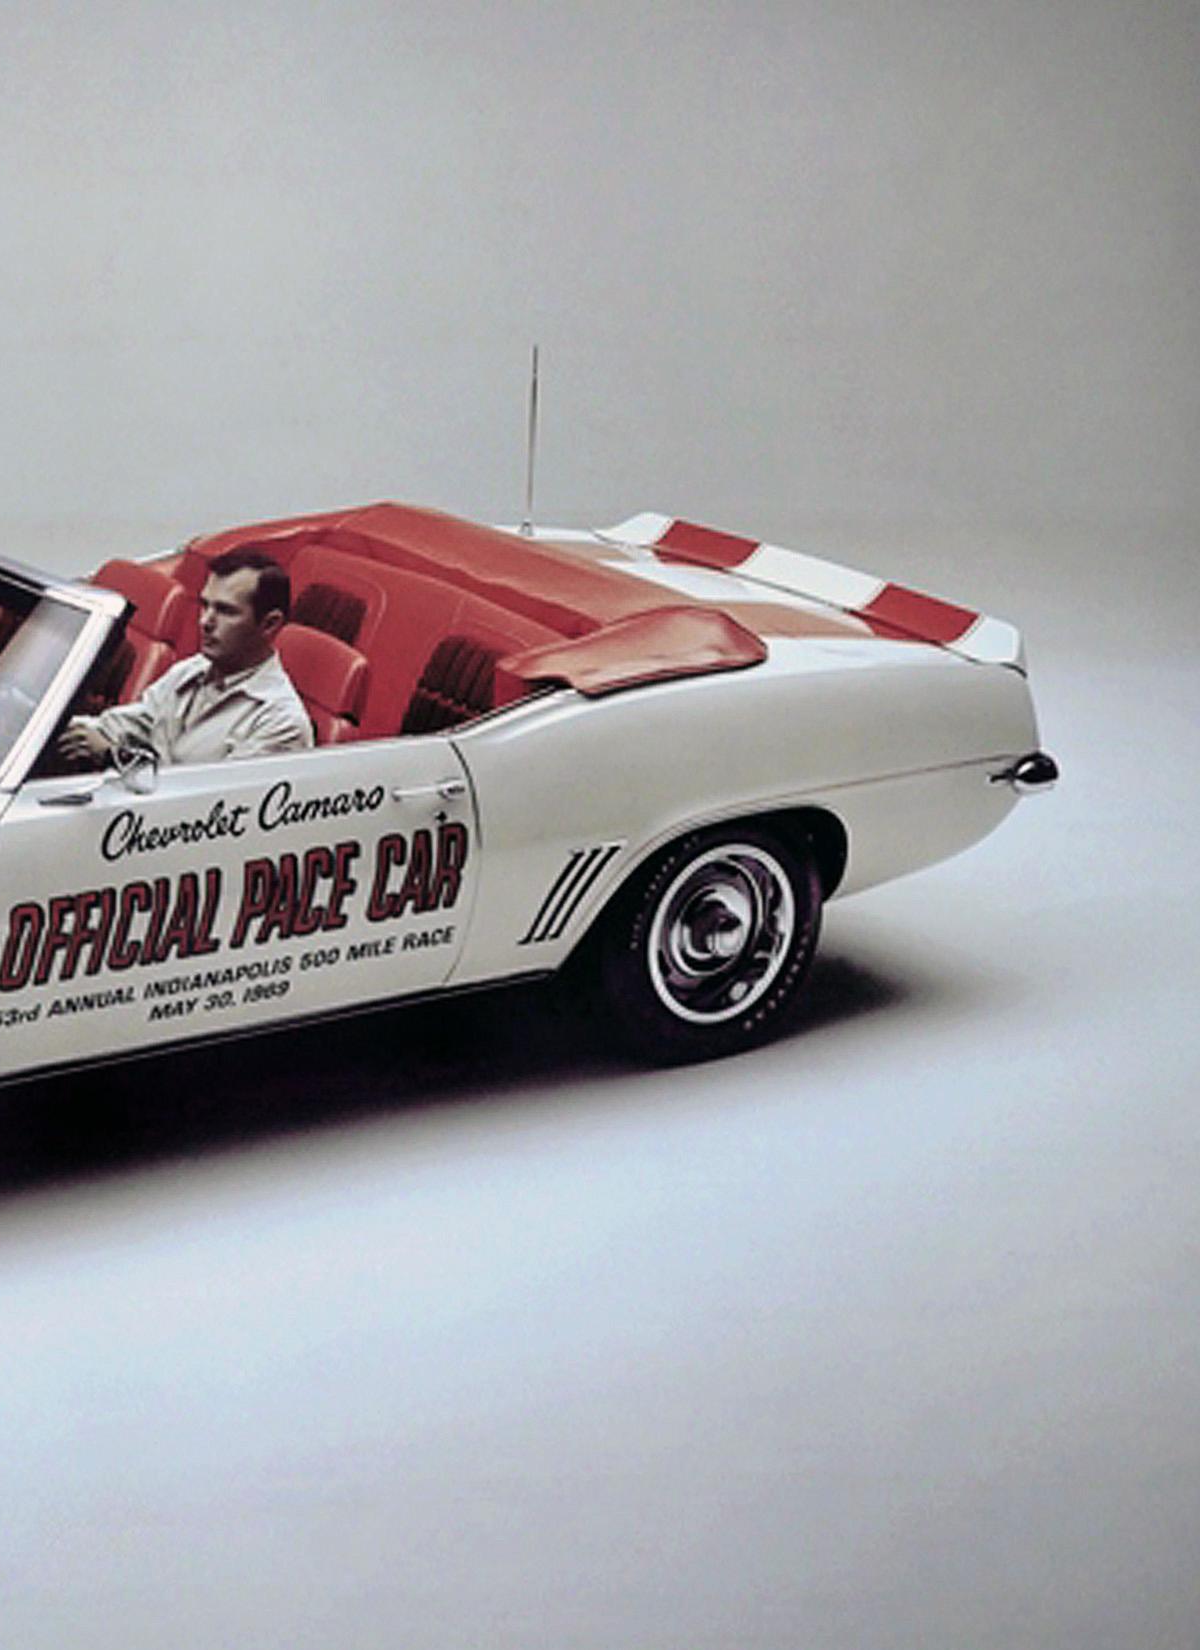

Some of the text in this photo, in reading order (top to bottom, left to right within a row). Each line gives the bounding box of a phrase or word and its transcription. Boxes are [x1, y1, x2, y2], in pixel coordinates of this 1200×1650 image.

[101, 781, 385, 861] Chevrolet Camaro
[229, 841, 360, 949] PACE
[366, 822, 468, 922] CAR
[47, 986, 136, 1018] ANNUAL
[143, 956, 293, 1000] INDIANAPOLIS
[300, 948, 340, 970] 500
[346, 936, 397, 961] MILE
[401, 926, 456, 951] RACE
[148, 997, 197, 1021] MAY
